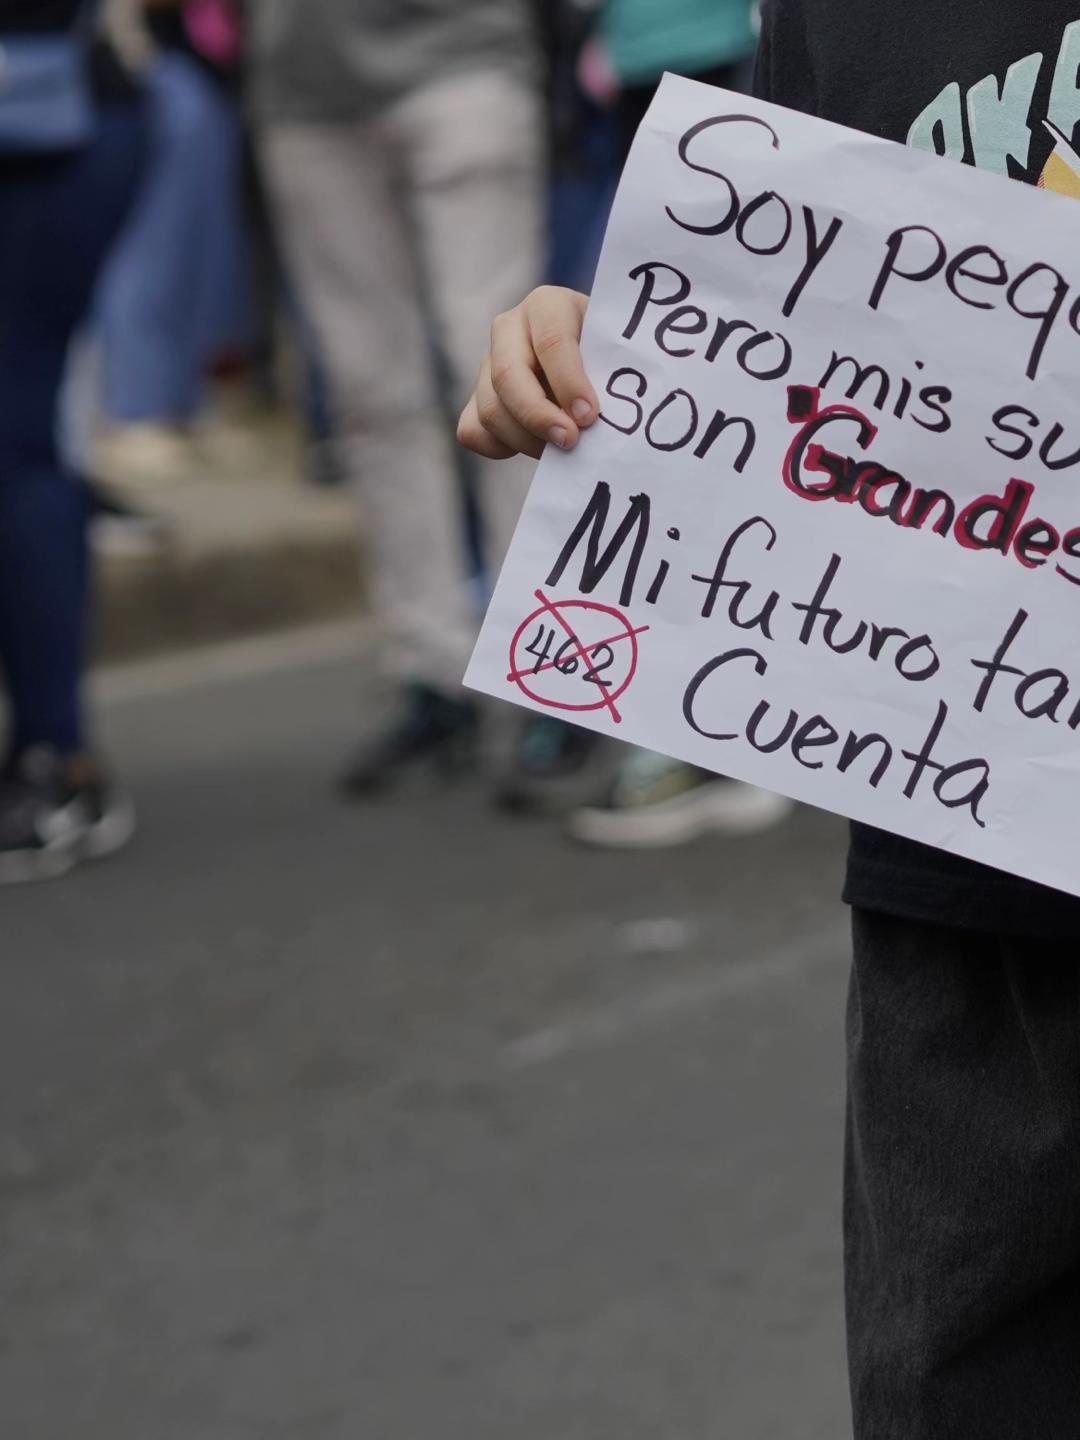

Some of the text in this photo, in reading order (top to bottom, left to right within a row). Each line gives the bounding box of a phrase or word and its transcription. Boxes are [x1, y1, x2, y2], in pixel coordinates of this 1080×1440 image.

[663, 113, 843, 318] Soy
[598, 366, 758, 474] son
[627, 260, 793, 382] Pero
[818, 349, 954, 434] mis
[524, 622, 615, 689] 462
[545, 480, 682, 609] Mi
[690, 514, 940, 684] futuro
[681, 646, 992, 829] Cuenta
